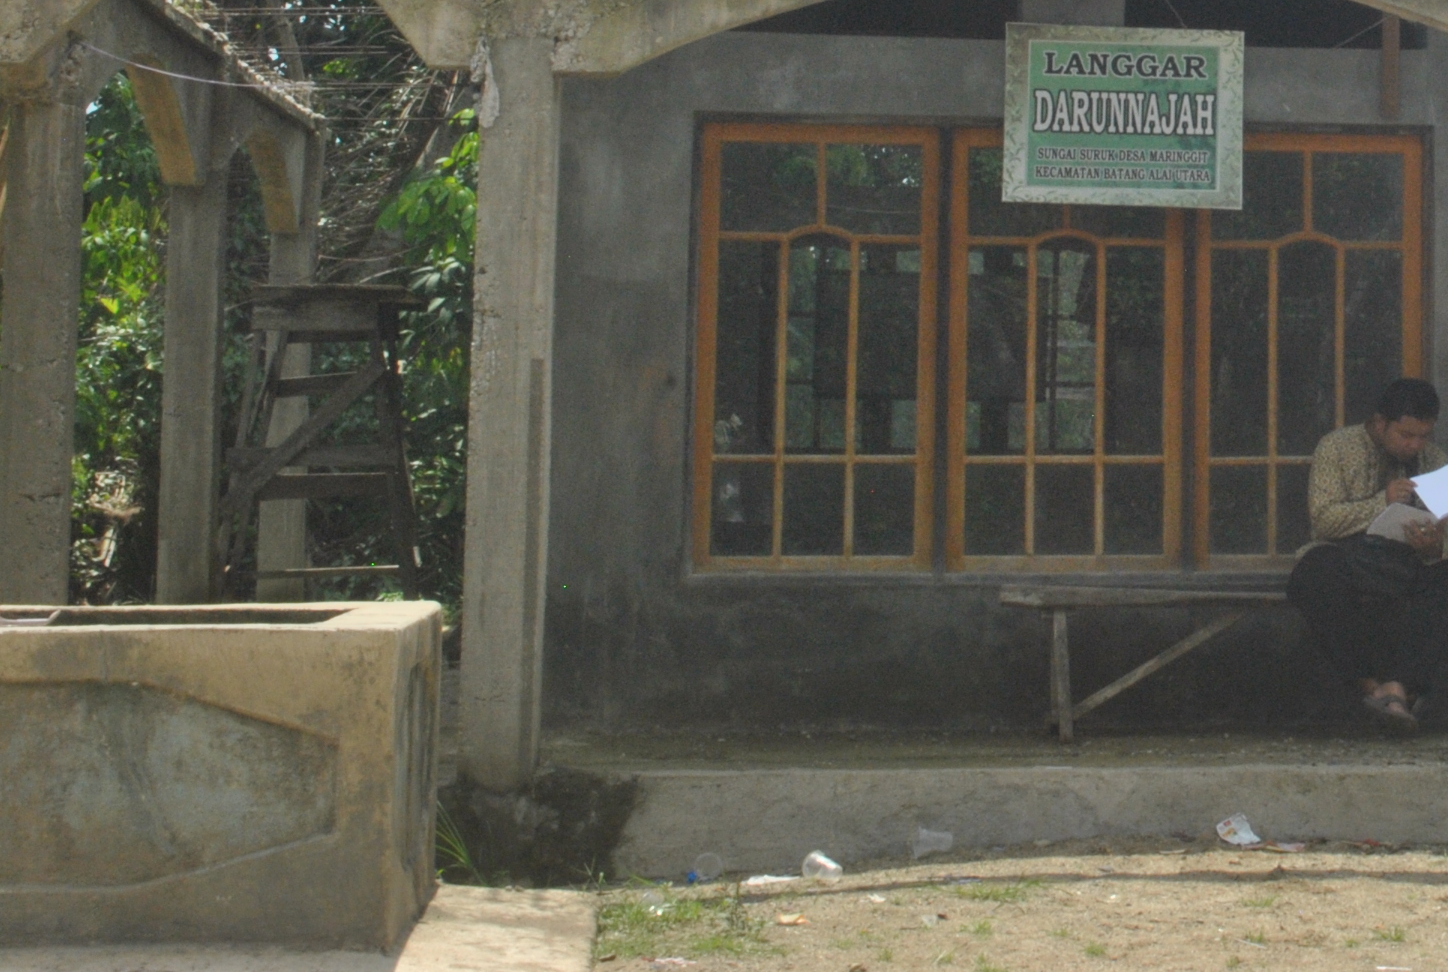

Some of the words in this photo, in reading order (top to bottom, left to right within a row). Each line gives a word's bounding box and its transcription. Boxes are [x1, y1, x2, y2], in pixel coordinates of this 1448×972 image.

[1044, 52, 1207, 78] LANGGAR
[1034, 90, 1215, 135] DARUNNAJAH
[1038, 148, 1076, 160] SUNGAI
[1080, 149, 1115, 161] SURUK
[1119, 150, 1146, 162] DESA
[1149, 150, 1208, 163] MARINGGIT
[1036, 166, 1100, 179] KECAMATAN
[1104, 168, 1145, 180] BATANG
[1148, 169, 1172, 181] ALAI
[1175, 170, 1210, 182] UTARA
